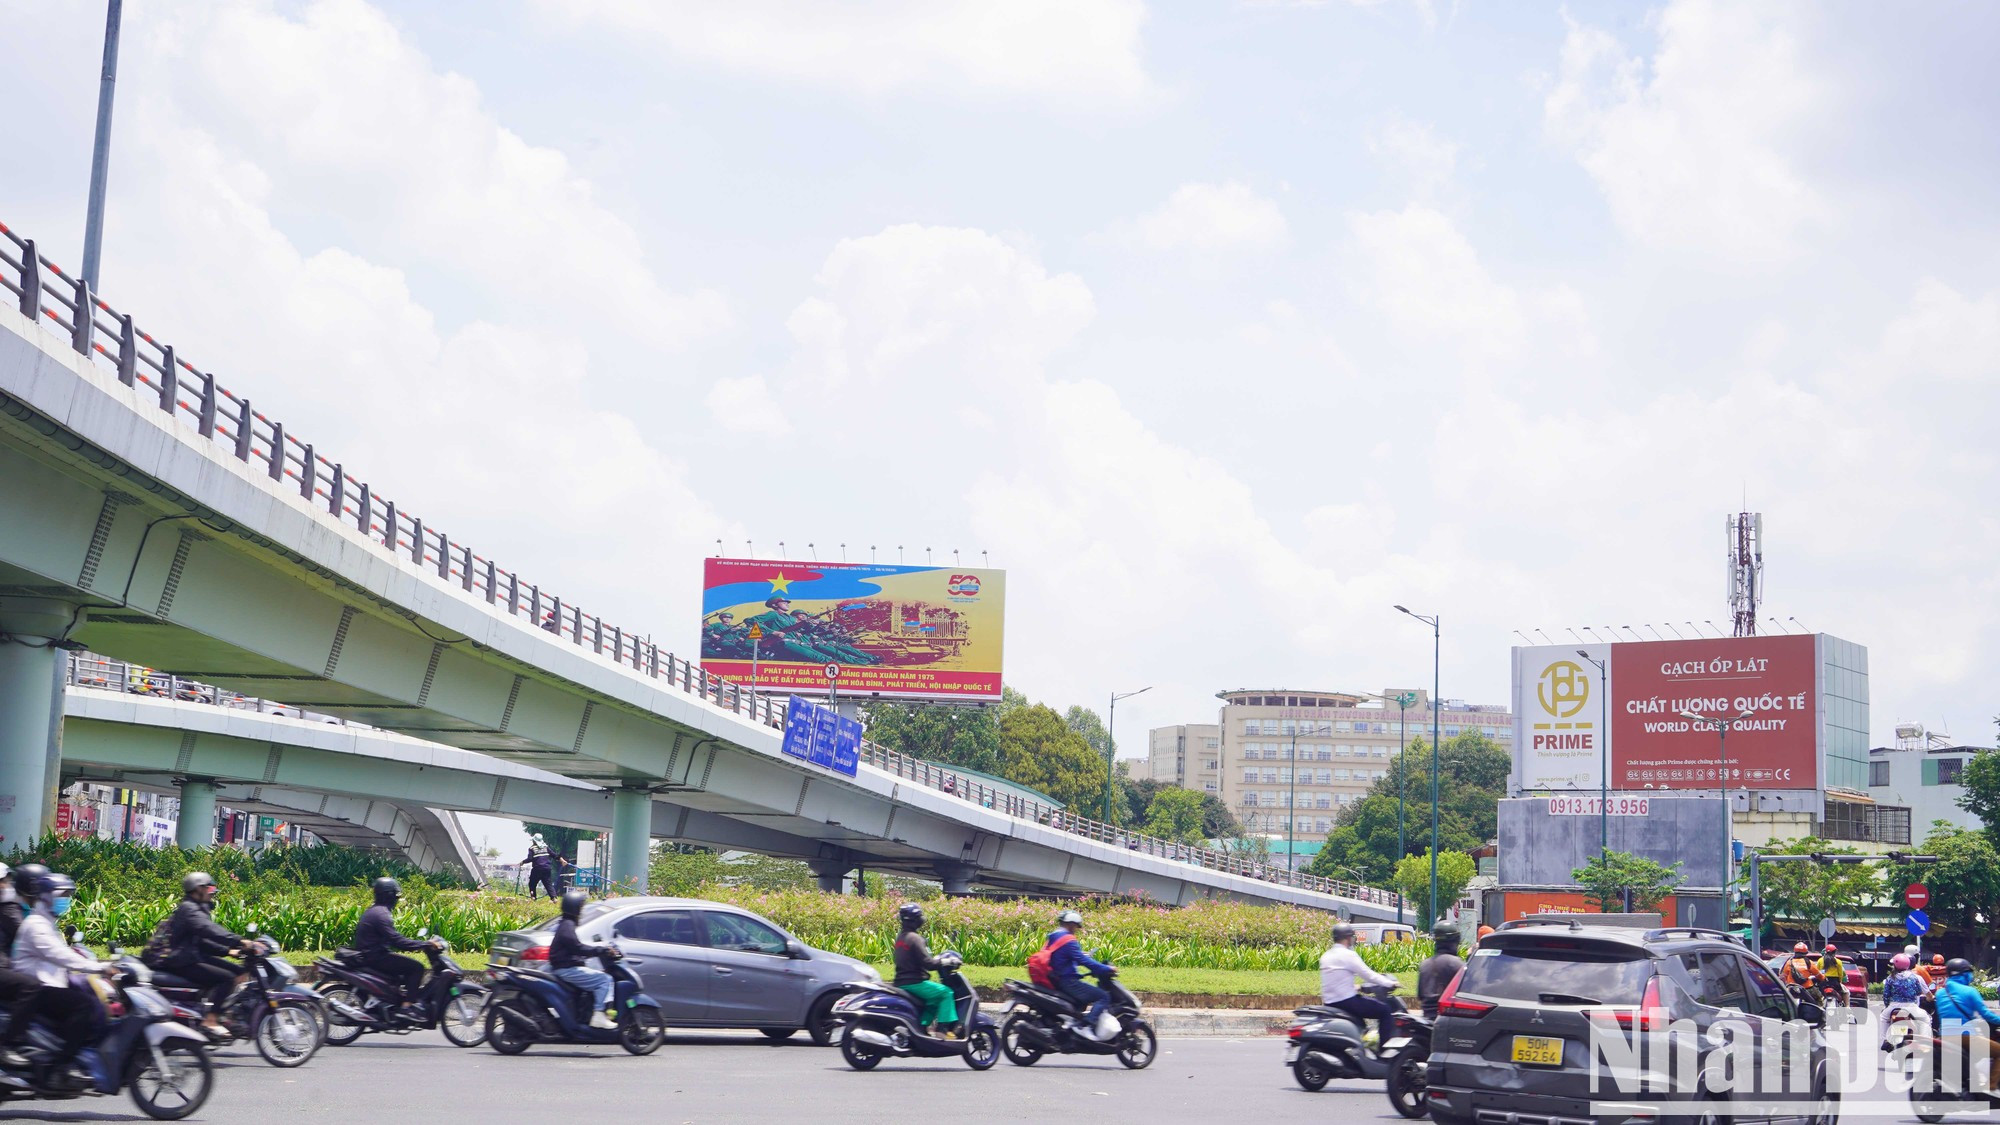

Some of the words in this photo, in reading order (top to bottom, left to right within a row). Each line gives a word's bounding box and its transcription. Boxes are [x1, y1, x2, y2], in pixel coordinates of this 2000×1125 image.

[799, 668, 810, 676] GIÁ
[900, 672, 916, 680] NĂM
[1661, 661, 1705, 677] GẠCH
[1710, 656, 1732, 673] ỐP
[1737, 657, 1768, 672] LÁT
[1626, 696, 1666, 713] CHẤT
[1672, 697, 1728, 715] LƯỢNG
[1734, 692, 1782, 711] QUỐC
[1788, 691, 1806, 710] TẾ
[1644, 722, 1689, 733] WORLD
[1733, 719, 1786, 731] QUALITY
[1533, 734, 1593, 750] PRIME
[1550, 799, 1648, 815] 0913.173.956
[1527, 1038, 1549, 1050] 50H
[1517, 1050, 1556, 1062] 592.64
